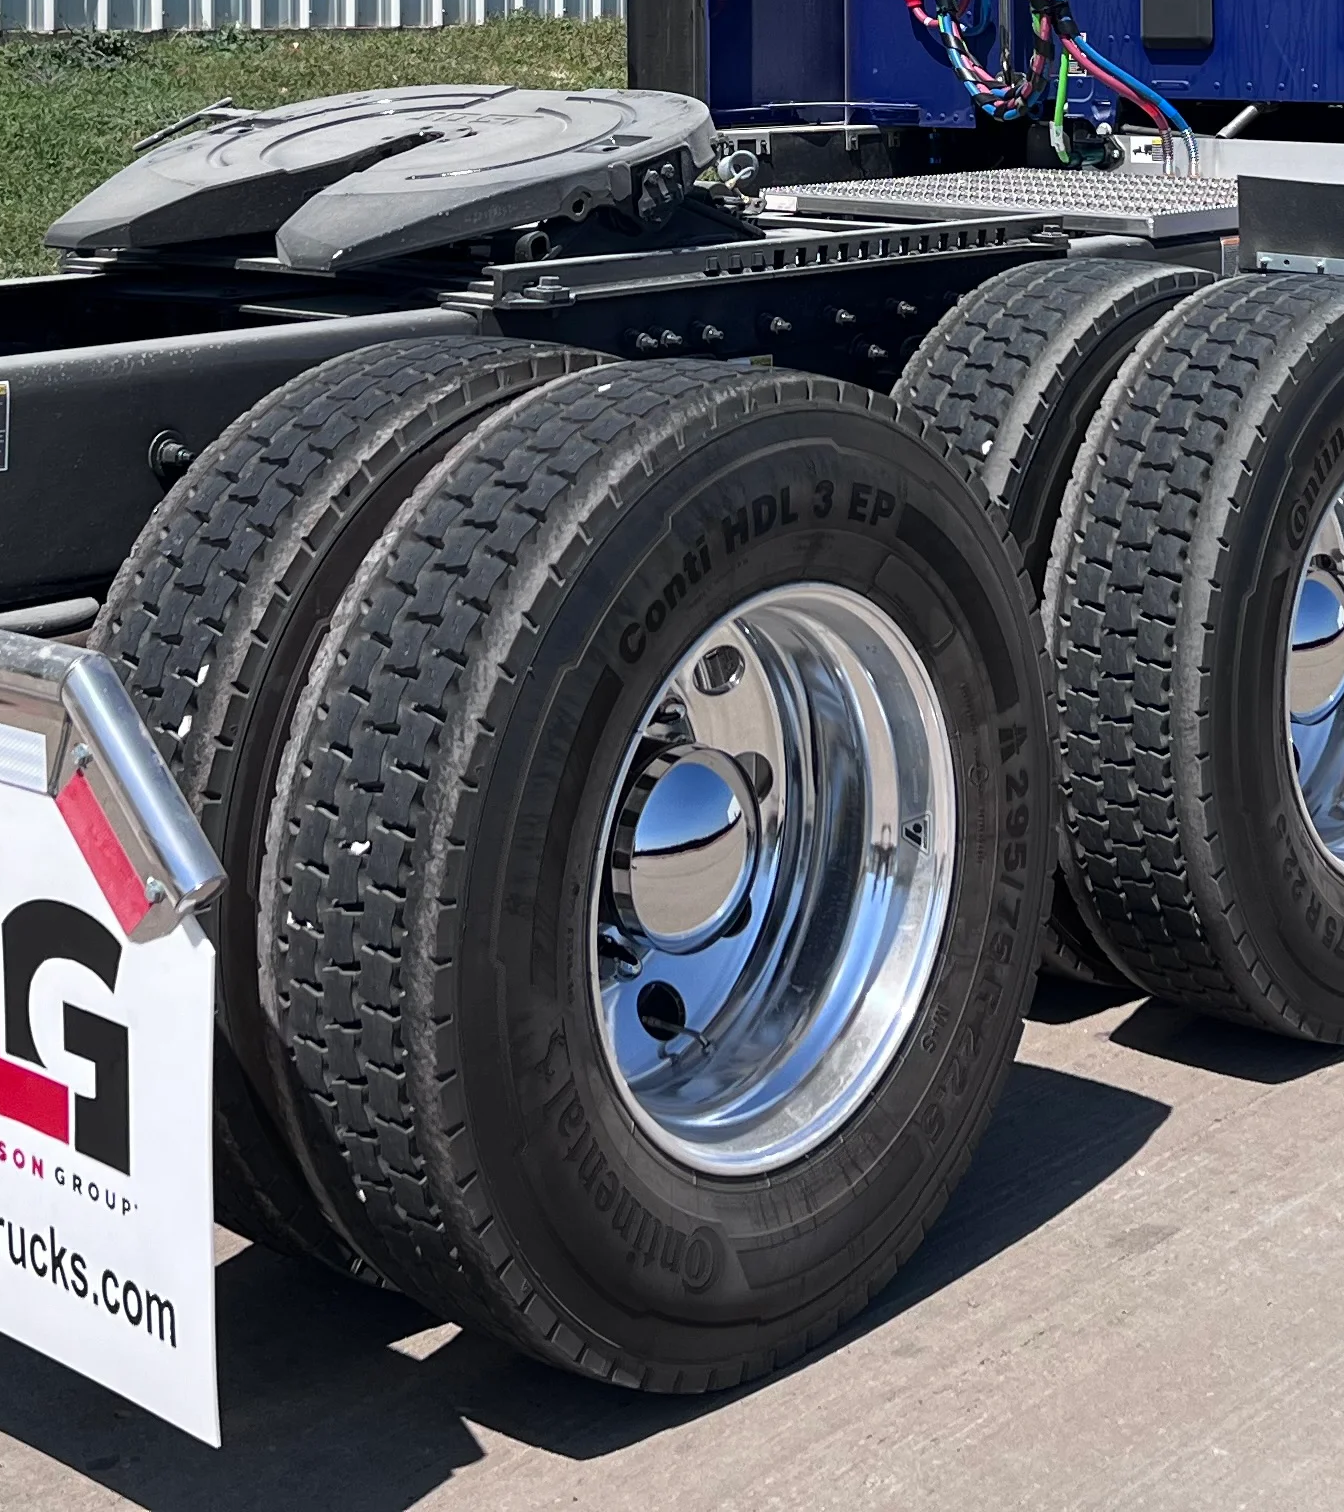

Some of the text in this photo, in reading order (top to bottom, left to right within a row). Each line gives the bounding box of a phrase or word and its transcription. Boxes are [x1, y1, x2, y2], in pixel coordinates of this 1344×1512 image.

[619, 479, 896, 664] Conti HDL 3 EP
[991, 768, 1030, 965] 295/75
[922, 1003, 951, 1054] M+S
[54, 1166, 132, 1216] GROUP
[543, 1071, 726, 1291] Continental
